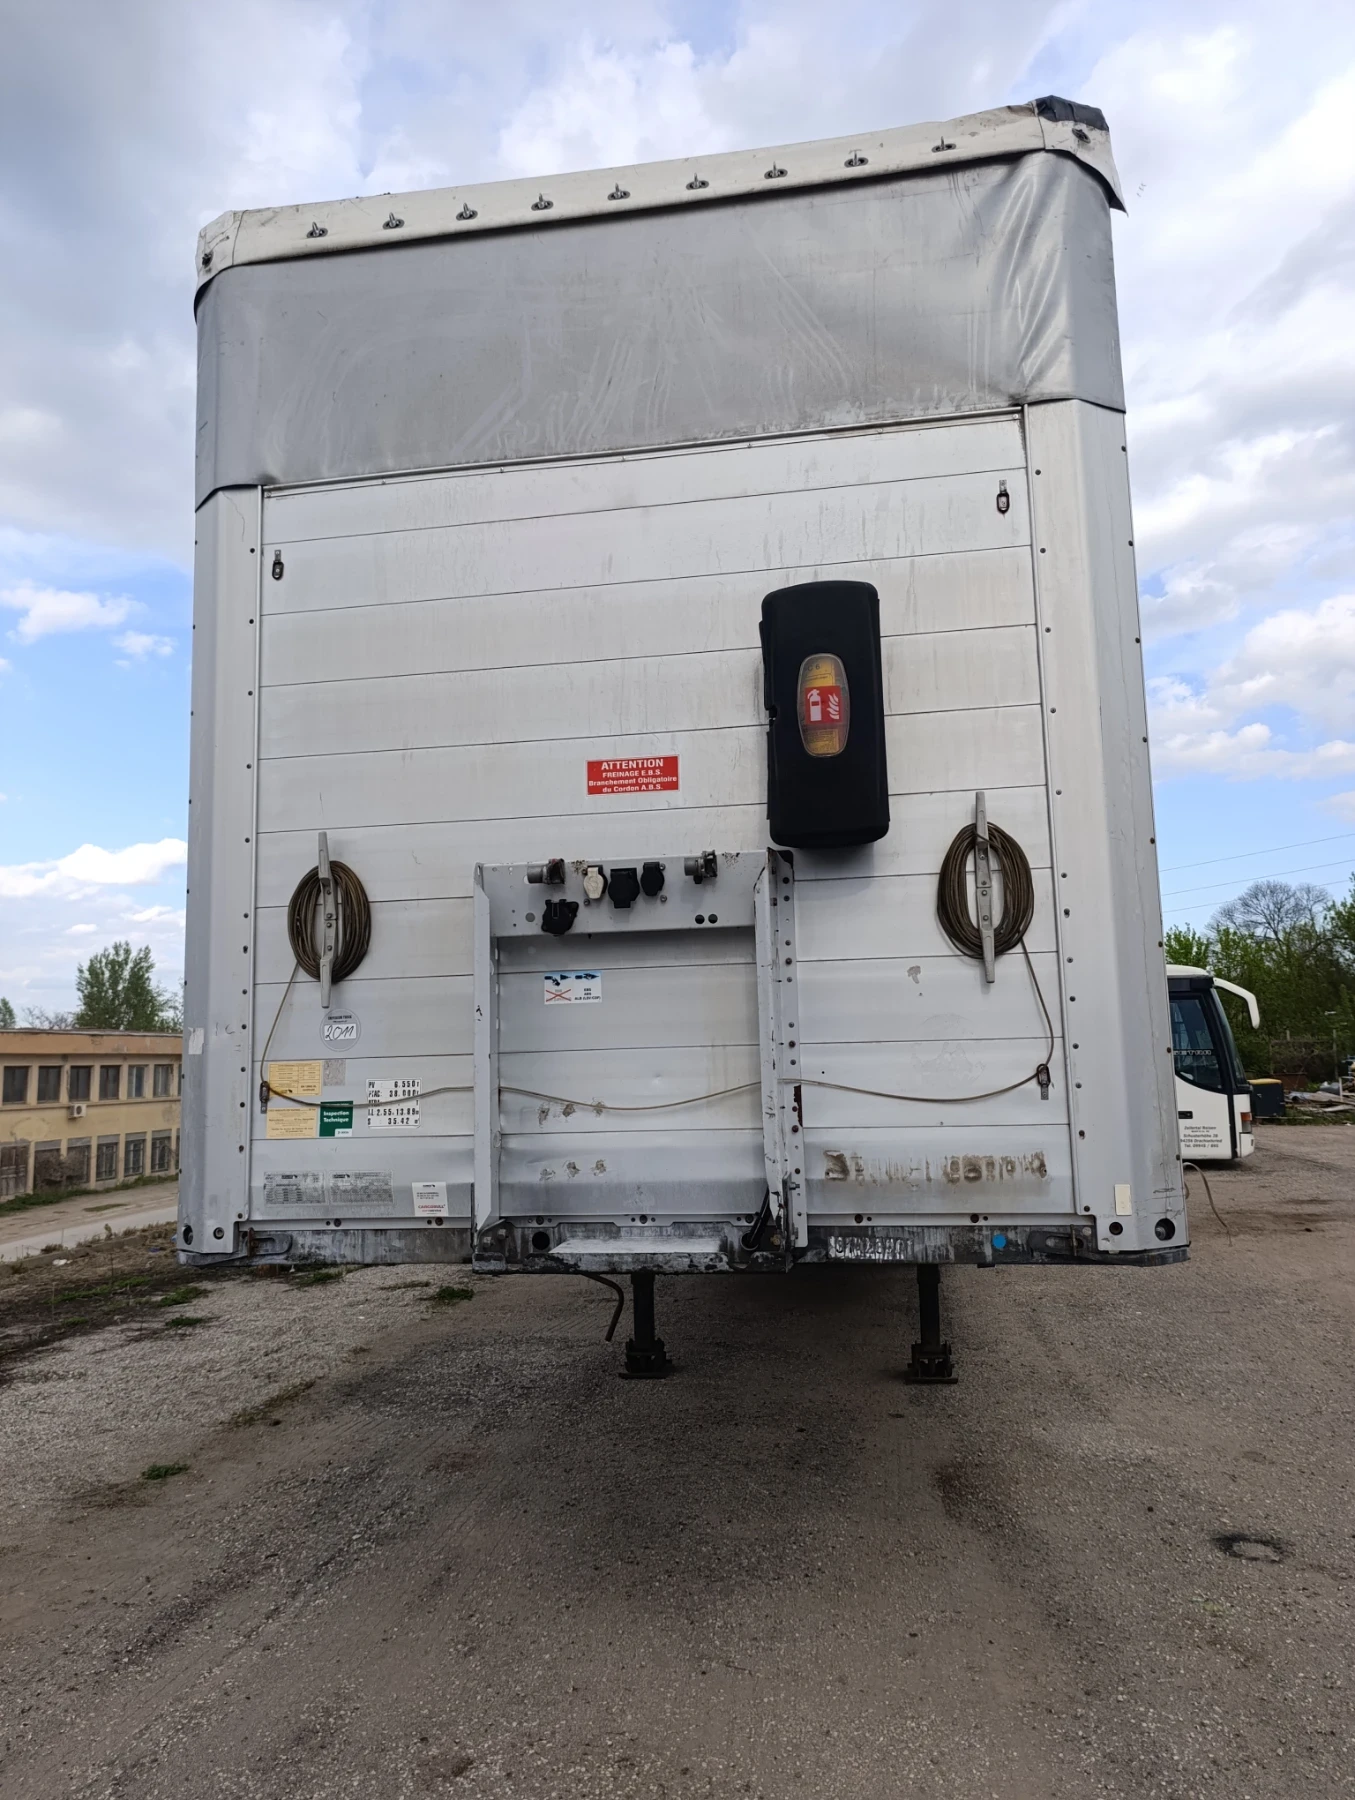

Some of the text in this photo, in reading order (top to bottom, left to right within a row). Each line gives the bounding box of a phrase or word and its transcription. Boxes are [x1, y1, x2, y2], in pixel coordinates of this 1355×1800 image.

[601, 758, 664, 770] ATTENTION
[602, 770, 640, 778] FREINAGE
[588, 776, 677, 786] Branchement Obligatoire
[325, 1025, 354, 1041] 2011
